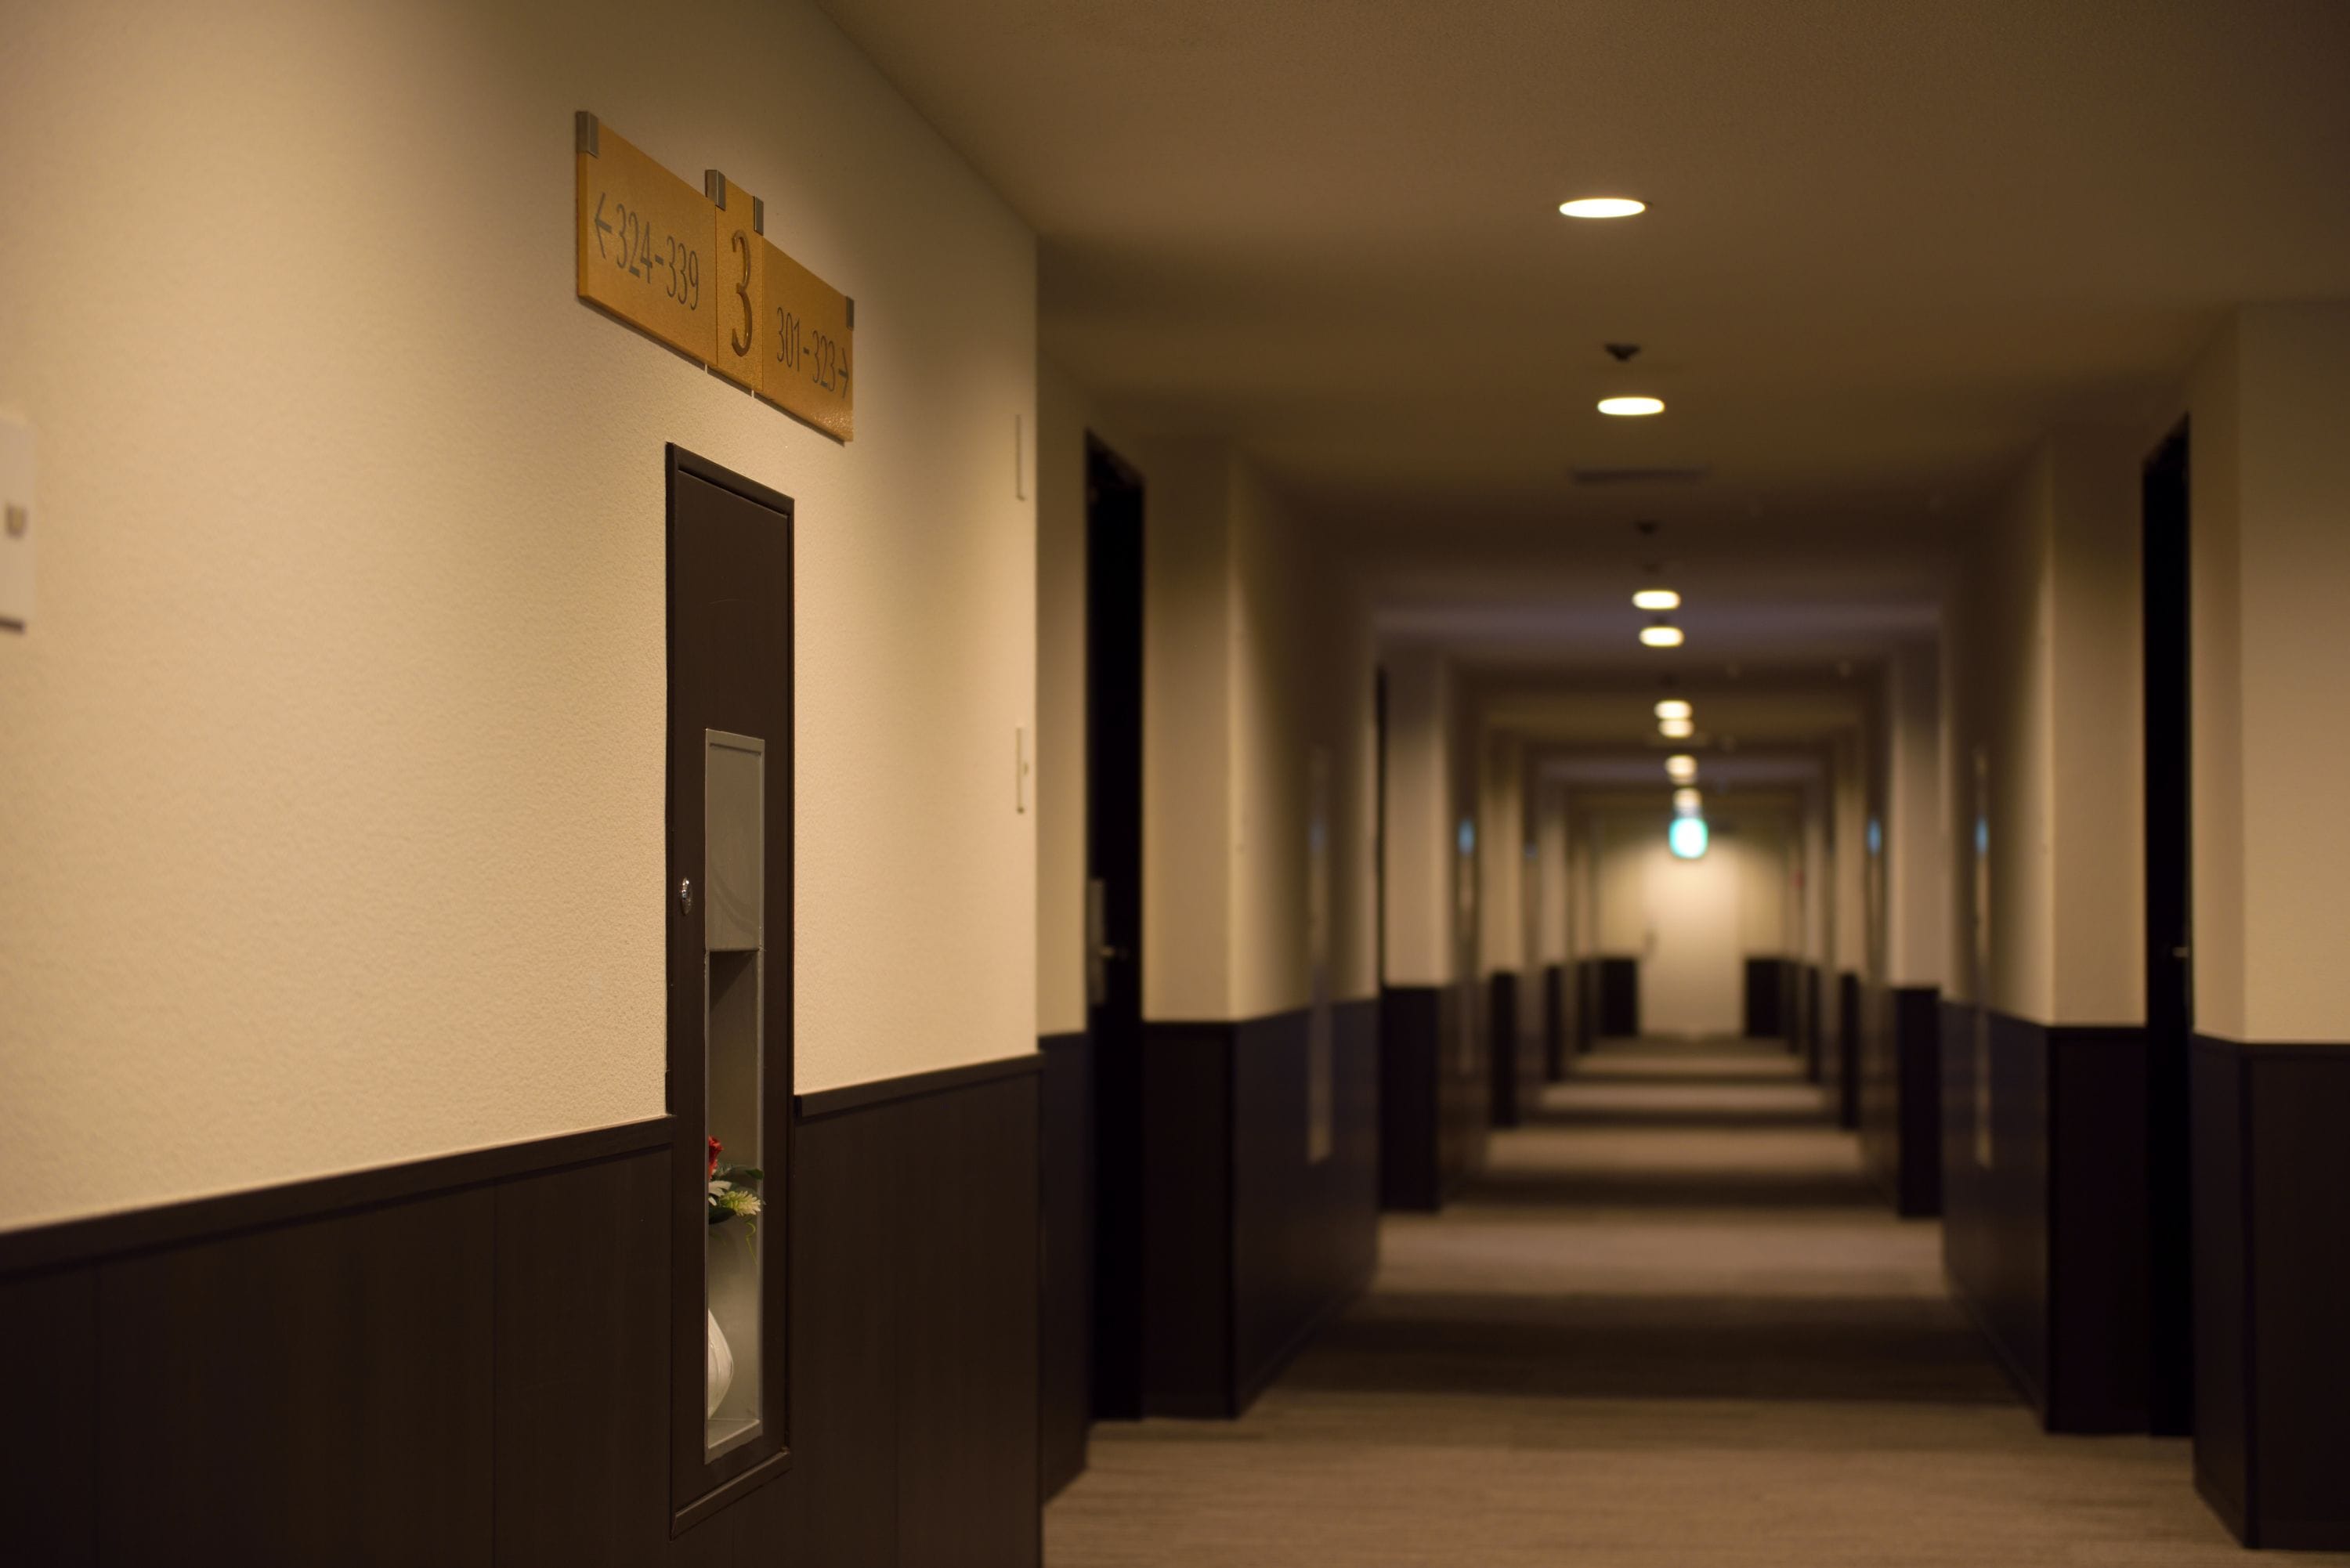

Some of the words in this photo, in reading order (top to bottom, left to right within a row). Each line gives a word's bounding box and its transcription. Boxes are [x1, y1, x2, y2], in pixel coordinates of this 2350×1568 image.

[616, 203, 699, 310] 324-339
[731, 229, 753, 357] 3
[776, 307, 835, 392] 301-323
